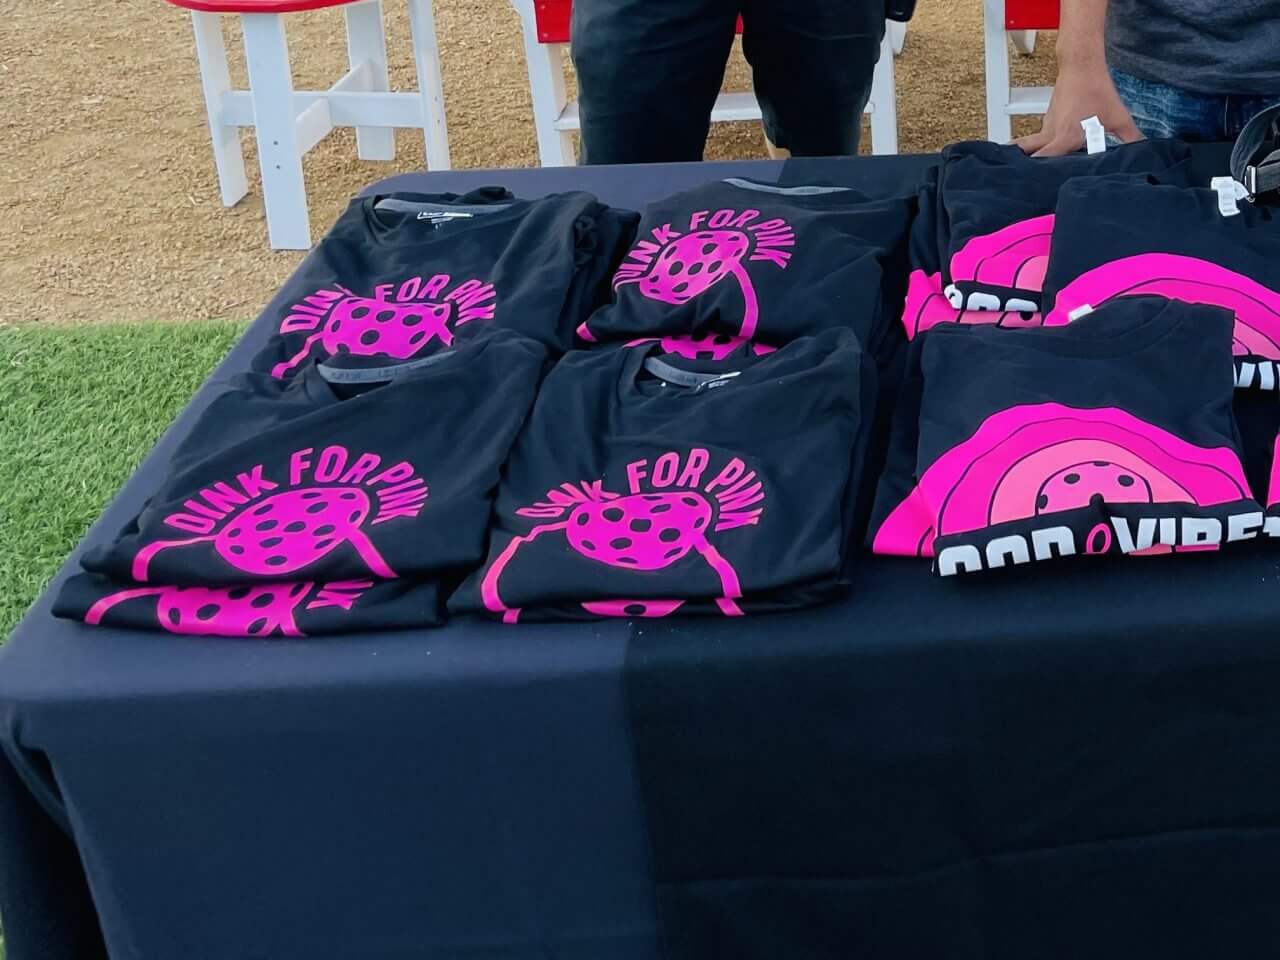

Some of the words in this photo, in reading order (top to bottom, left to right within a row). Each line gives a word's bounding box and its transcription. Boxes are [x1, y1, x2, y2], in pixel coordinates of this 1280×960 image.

[689, 208, 760, 230] FOR
[748, 218, 796, 269] PINK
[374, 273, 450, 304] FOR
[162, 464, 279, 535] DINK
[289, 444, 382, 486] FOR
[366, 460, 429, 525] PINK
[626, 447, 710, 494] FOR
[704, 457, 765, 532] PINK
[931, 525, 1077, 578] OOD
